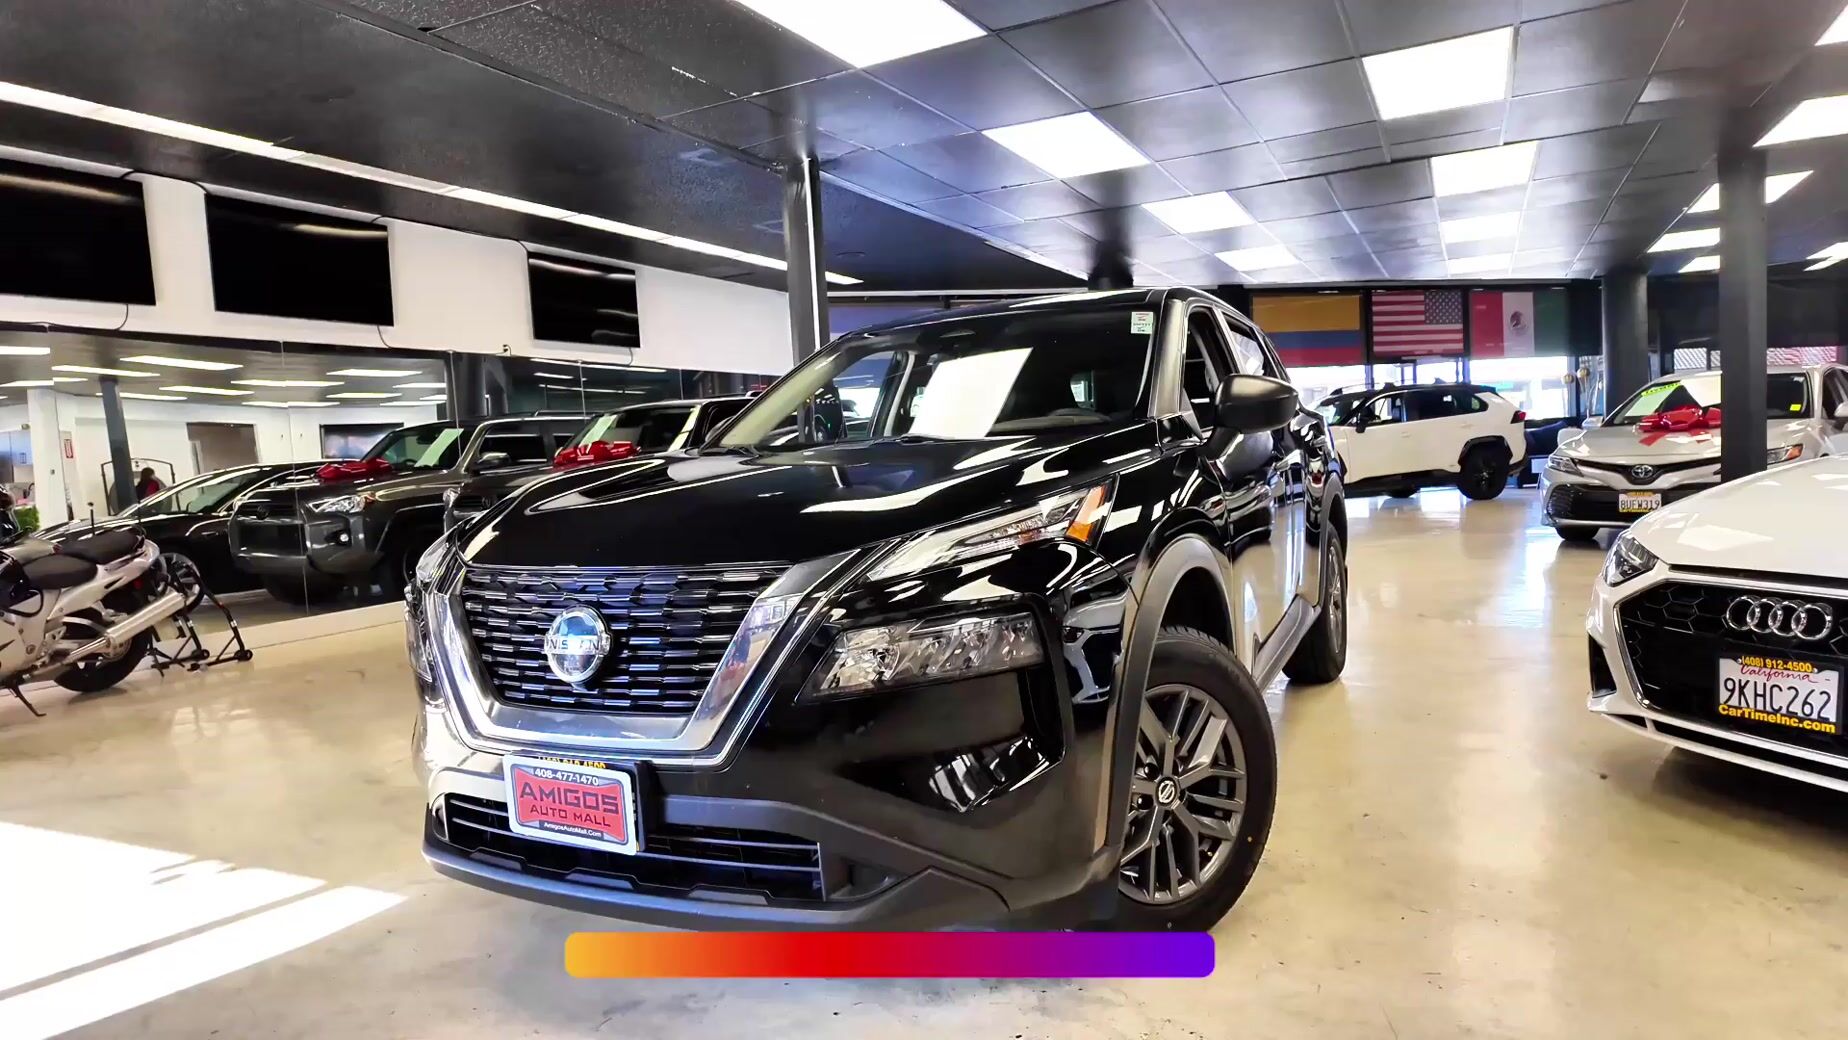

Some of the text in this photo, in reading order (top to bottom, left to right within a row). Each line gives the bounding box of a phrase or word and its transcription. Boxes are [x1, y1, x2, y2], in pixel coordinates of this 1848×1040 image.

[550, 637, 600, 651] NISAN
[1741, 664, 1819, 684] California
[1742, 655, 1812, 673] (408) 912-4500
[1723, 677, 1832, 721] 9KHC262
[1718, 704, 1836, 733] CarTimeInc.com
[534, 768, 599, 786] 408-477-1470
[519, 782, 619, 815] AMIGOS
[530, 804, 611, 828] AUTO MALL
